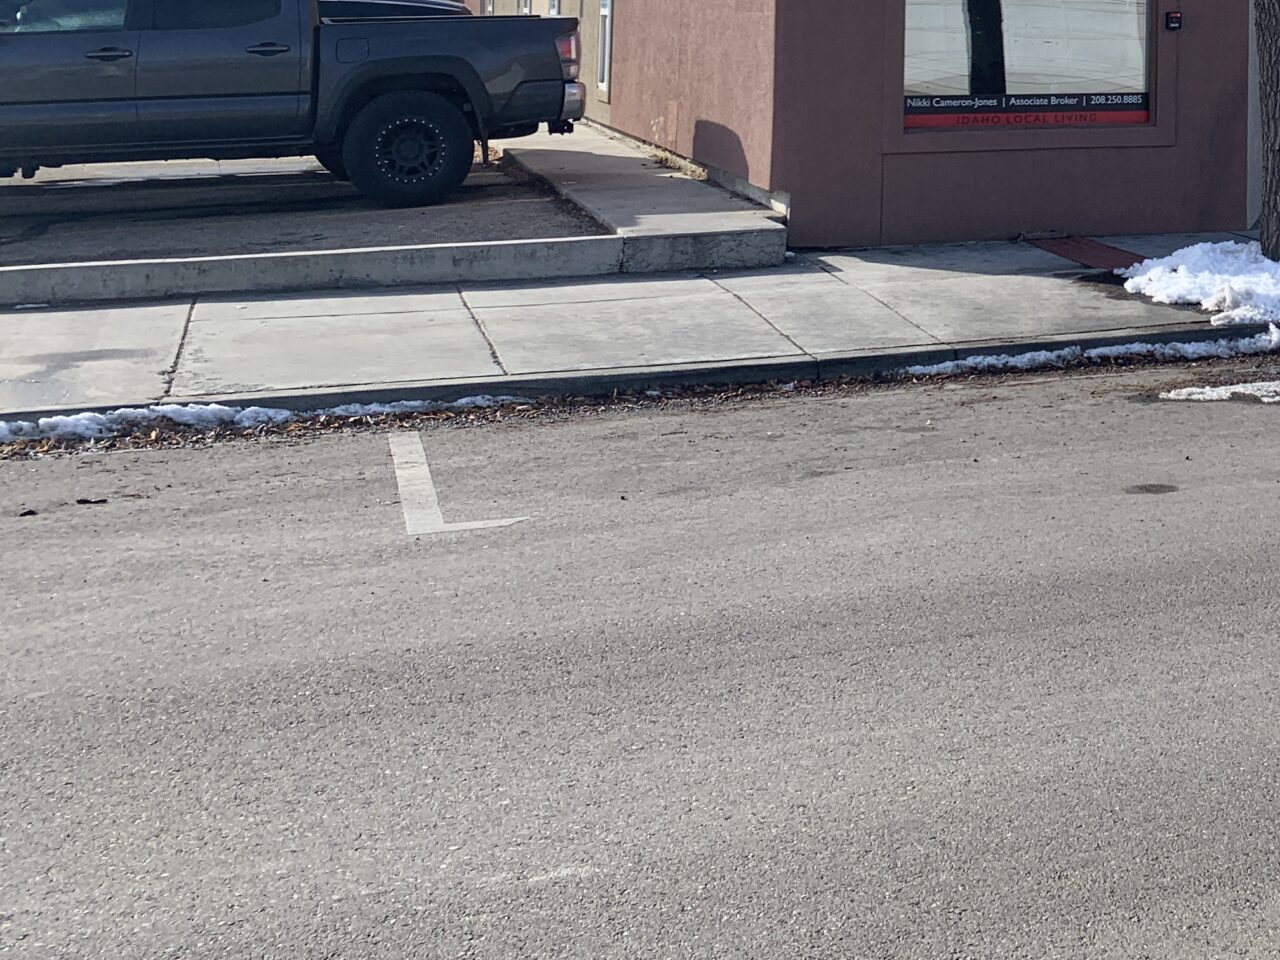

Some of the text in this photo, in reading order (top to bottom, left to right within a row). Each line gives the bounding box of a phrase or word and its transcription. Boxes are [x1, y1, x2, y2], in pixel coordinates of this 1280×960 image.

[906, 95, 1142, 109] Nikki Cameron-Jones Associate Broker 208.250.8885
[956, 113, 1097, 125] IDAHO LOCAL LIVING
